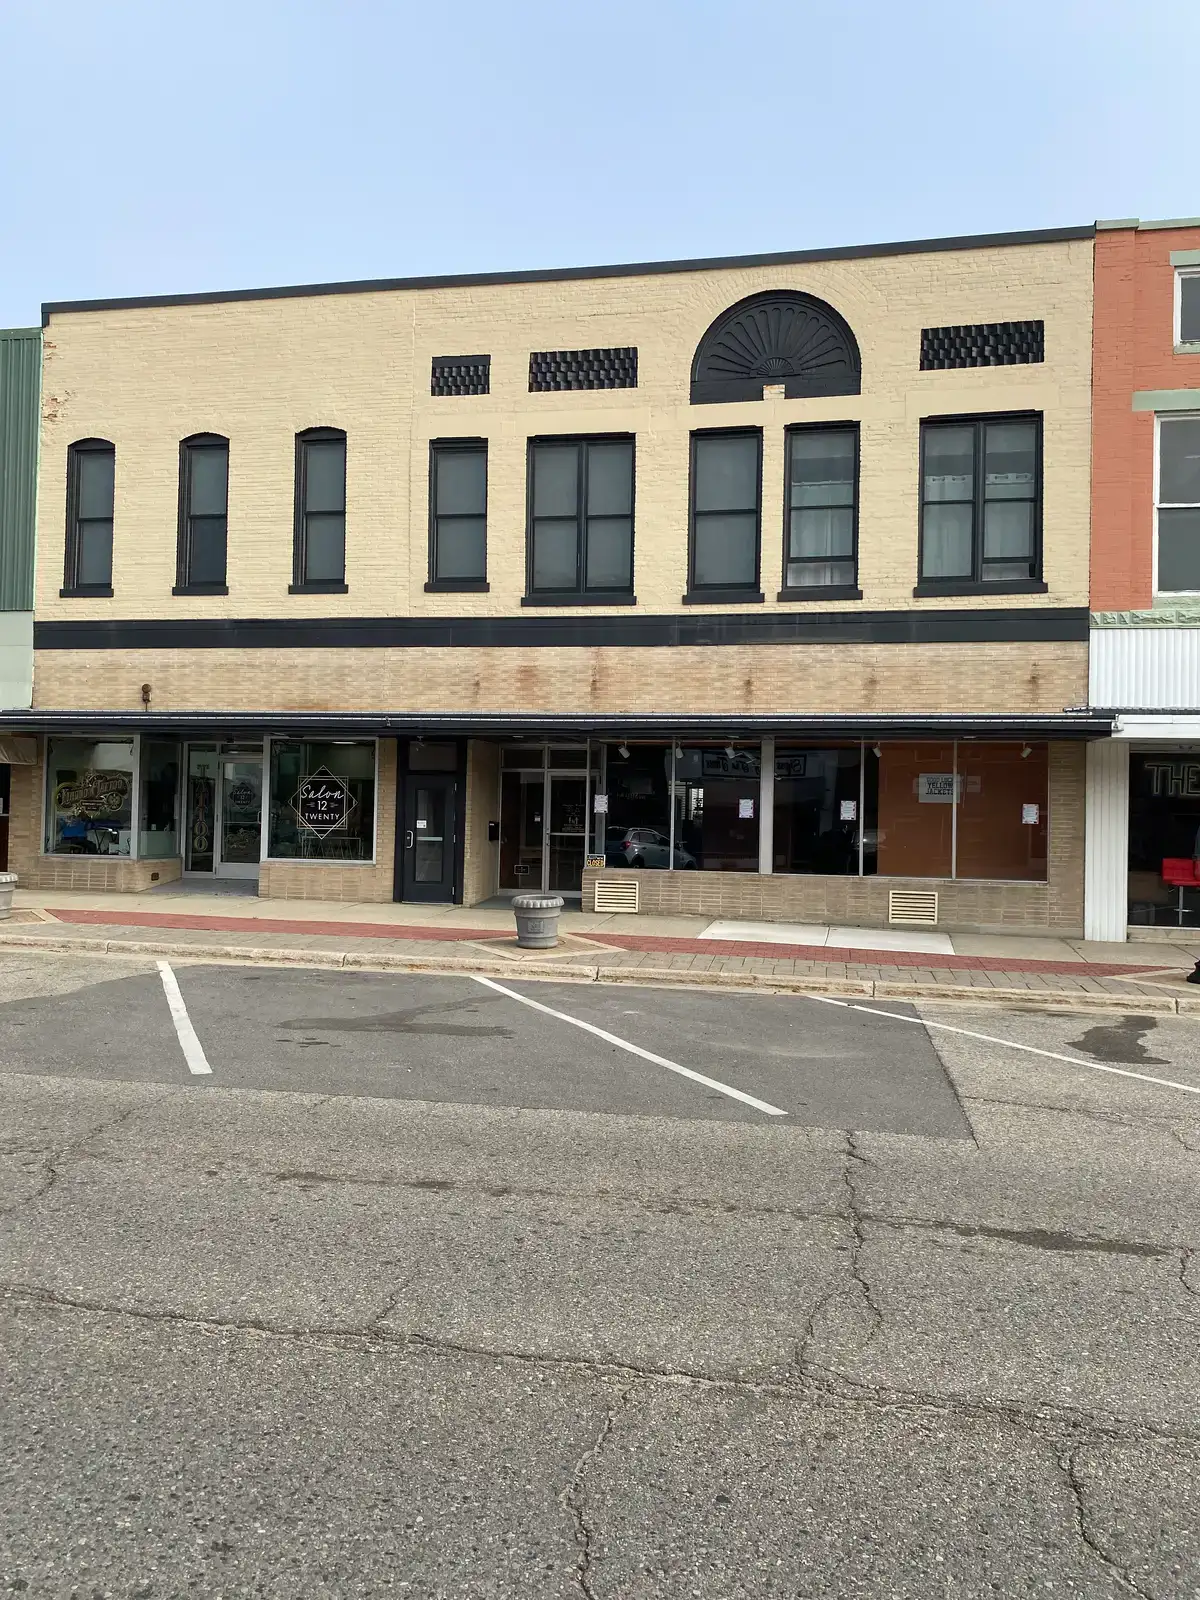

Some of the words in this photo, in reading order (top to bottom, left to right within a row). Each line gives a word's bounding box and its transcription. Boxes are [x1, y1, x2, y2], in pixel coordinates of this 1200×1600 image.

[1144, 762, 1200, 796] THE
[300, 784, 344, 799] Salon
[317, 800, 328, 811] 12
[586, 859, 604, 868] CLOSED
